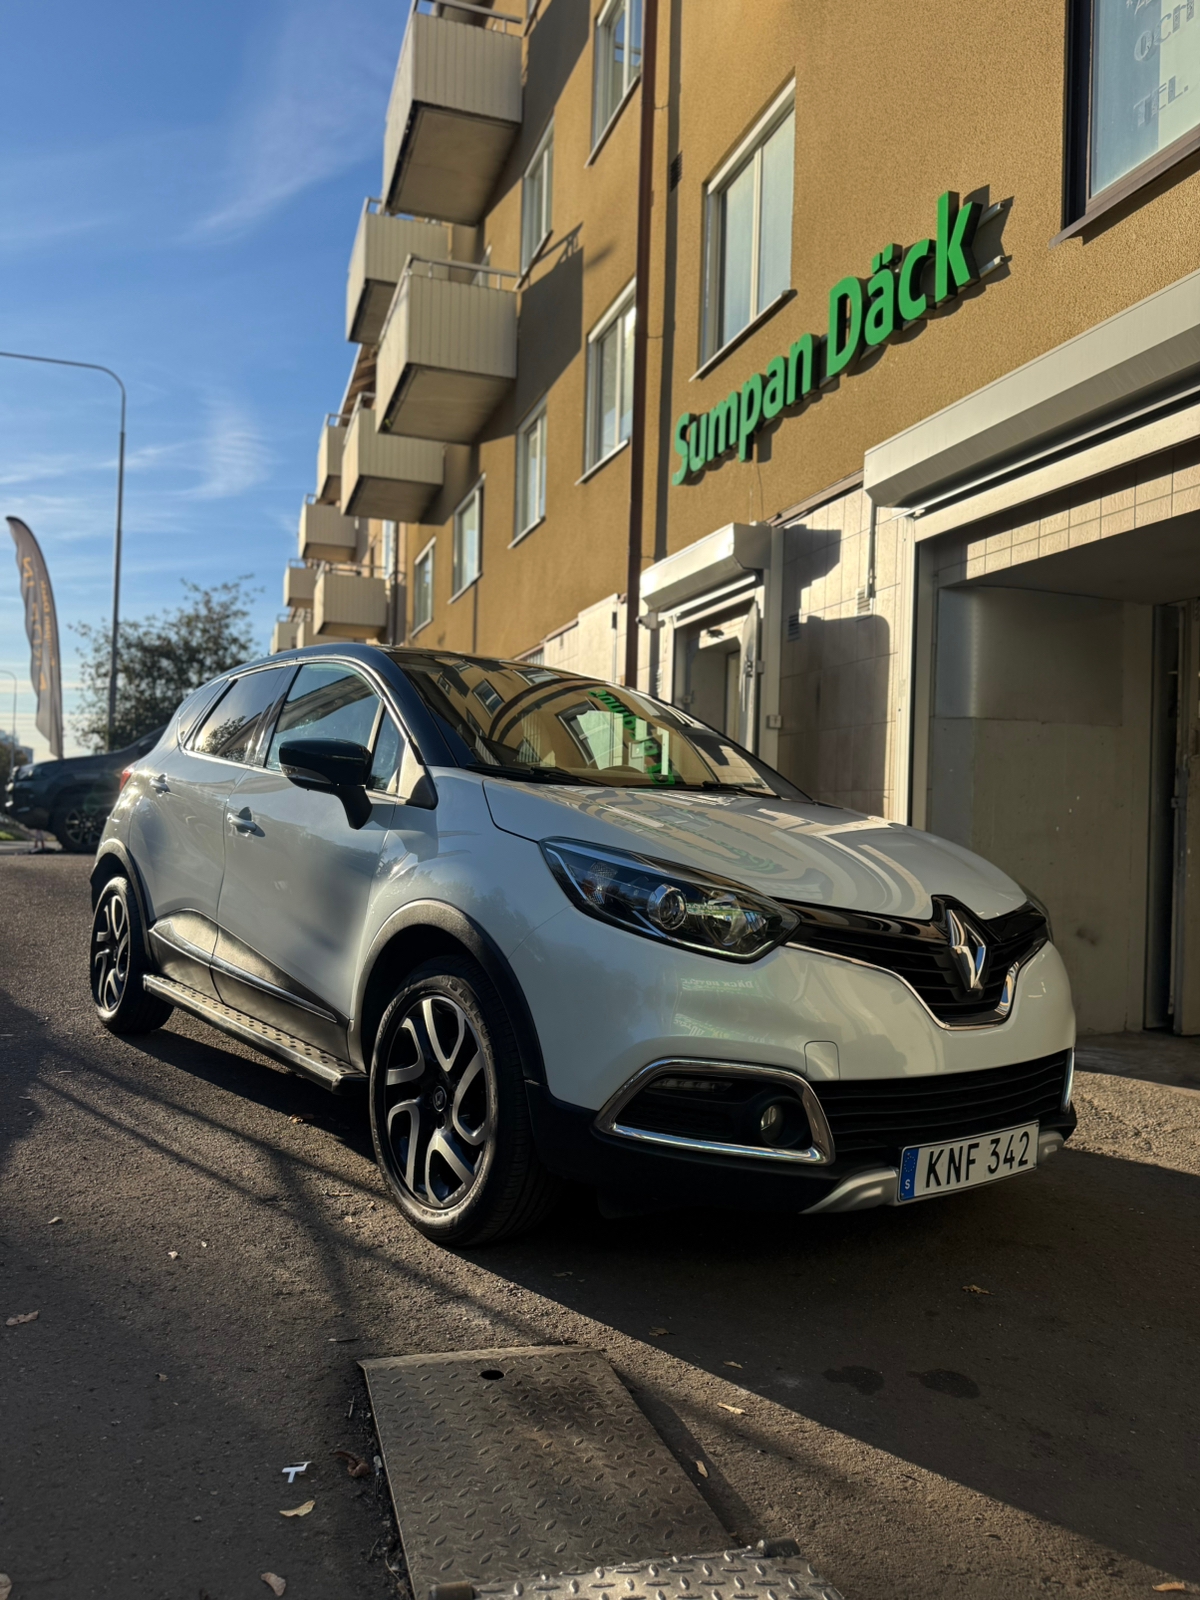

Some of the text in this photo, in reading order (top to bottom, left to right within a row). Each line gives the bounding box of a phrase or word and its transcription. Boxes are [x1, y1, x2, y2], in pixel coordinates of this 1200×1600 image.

[671, 190, 981, 486] Sumpan Däck
[904, 1178, 911, 1190] S
[926, 1131, 1030, 1188] KNF 342
